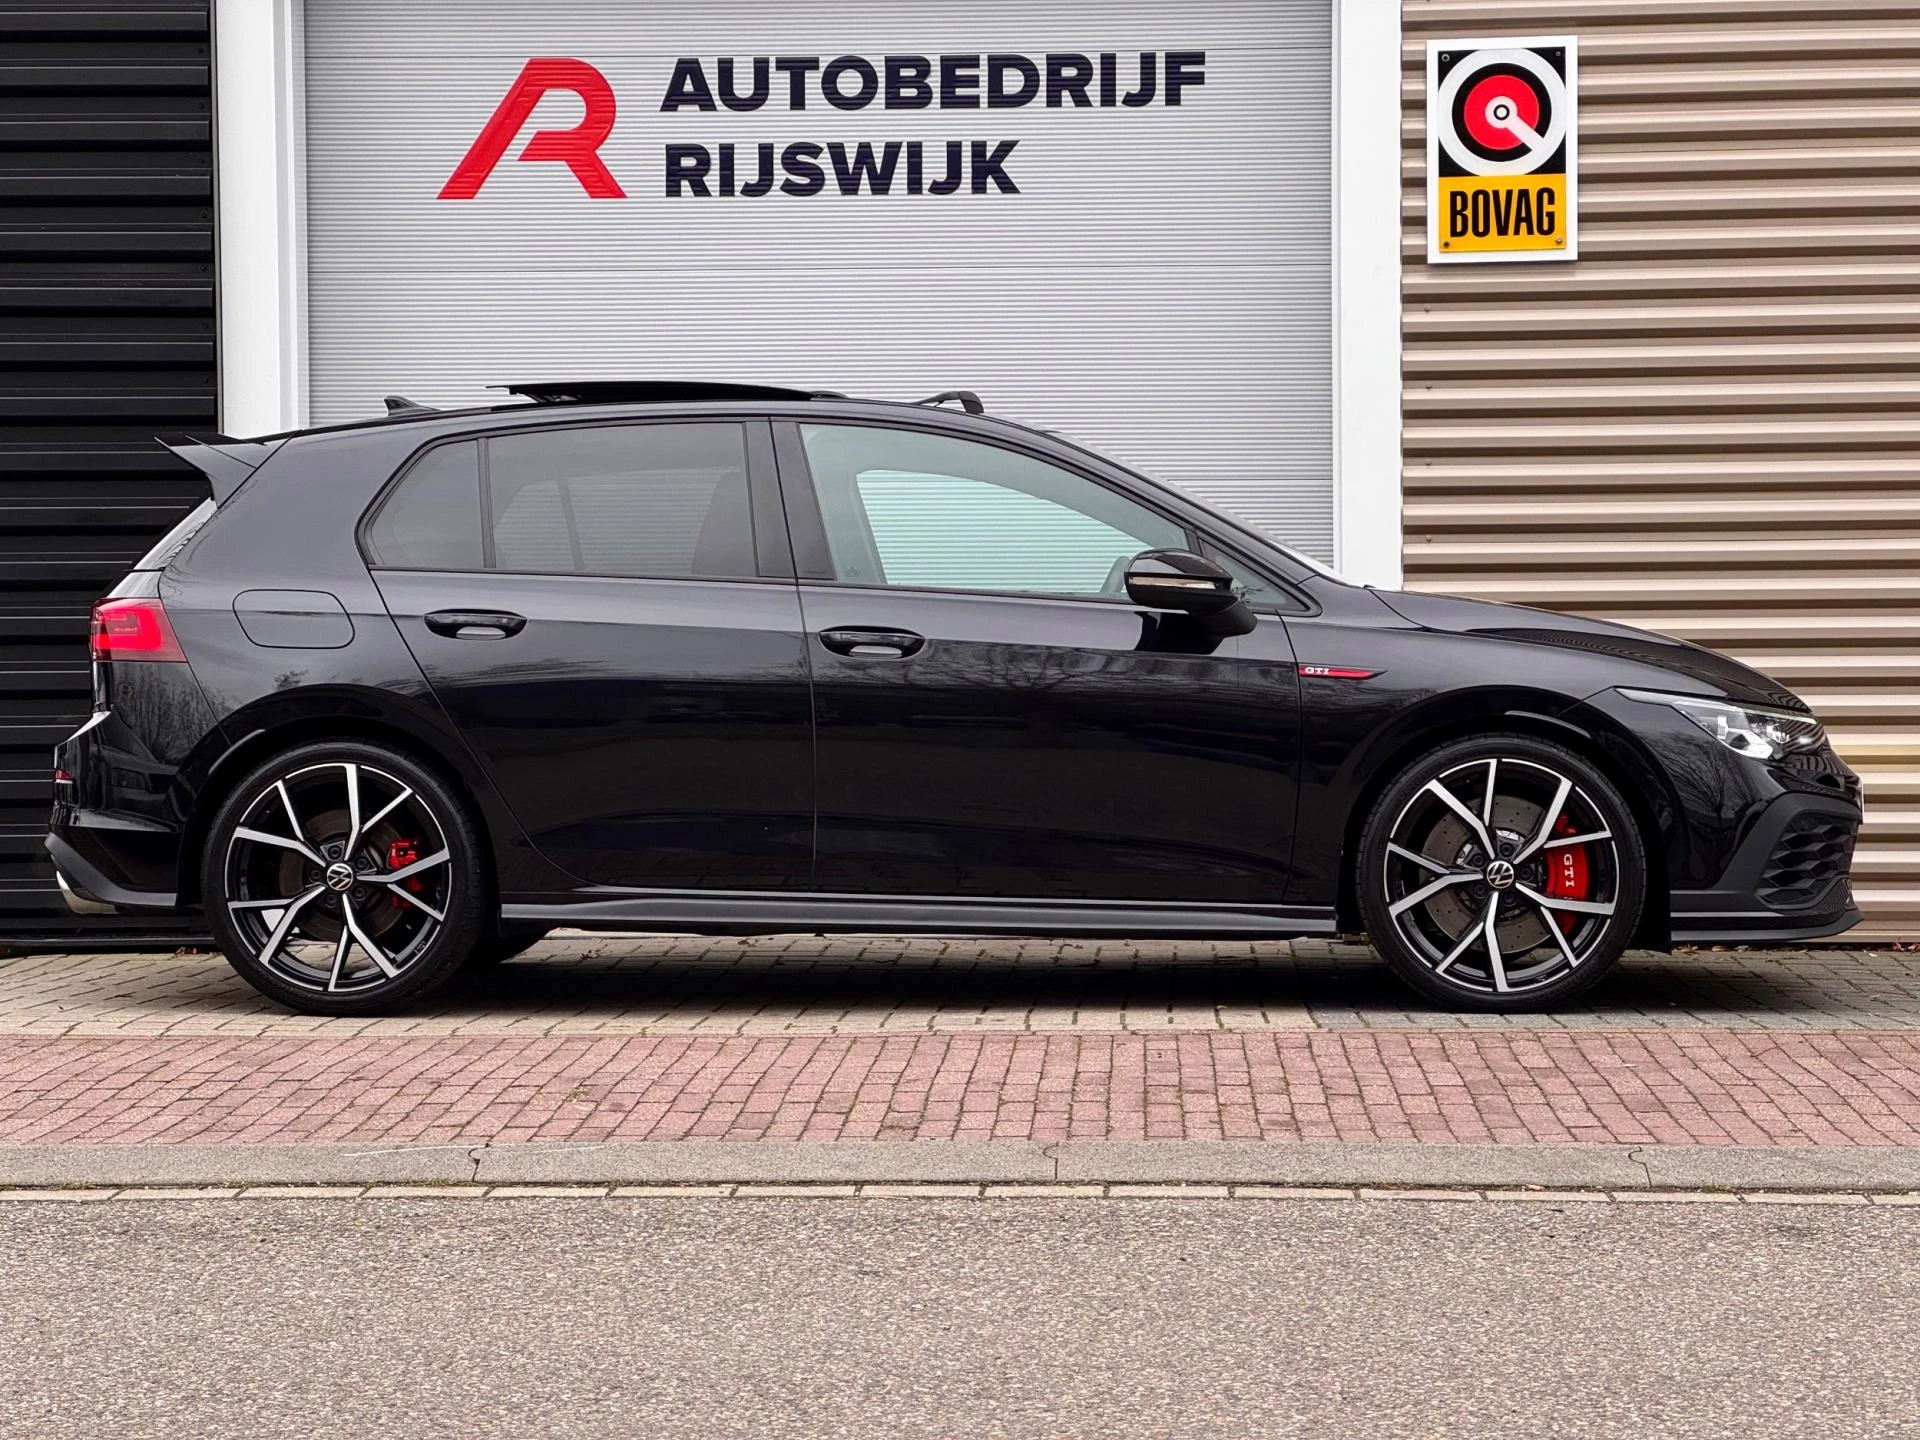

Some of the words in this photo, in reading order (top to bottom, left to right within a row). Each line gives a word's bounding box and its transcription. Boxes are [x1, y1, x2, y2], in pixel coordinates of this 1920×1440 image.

[660, 51, 1206, 112] AUTOBEDRIJF
[665, 140, 1020, 198] RIJSWIJK
[1449, 187, 1555, 238] BOVAG
[1305, 667, 1330, 675] GTI
[1563, 853, 1575, 887] GTI
